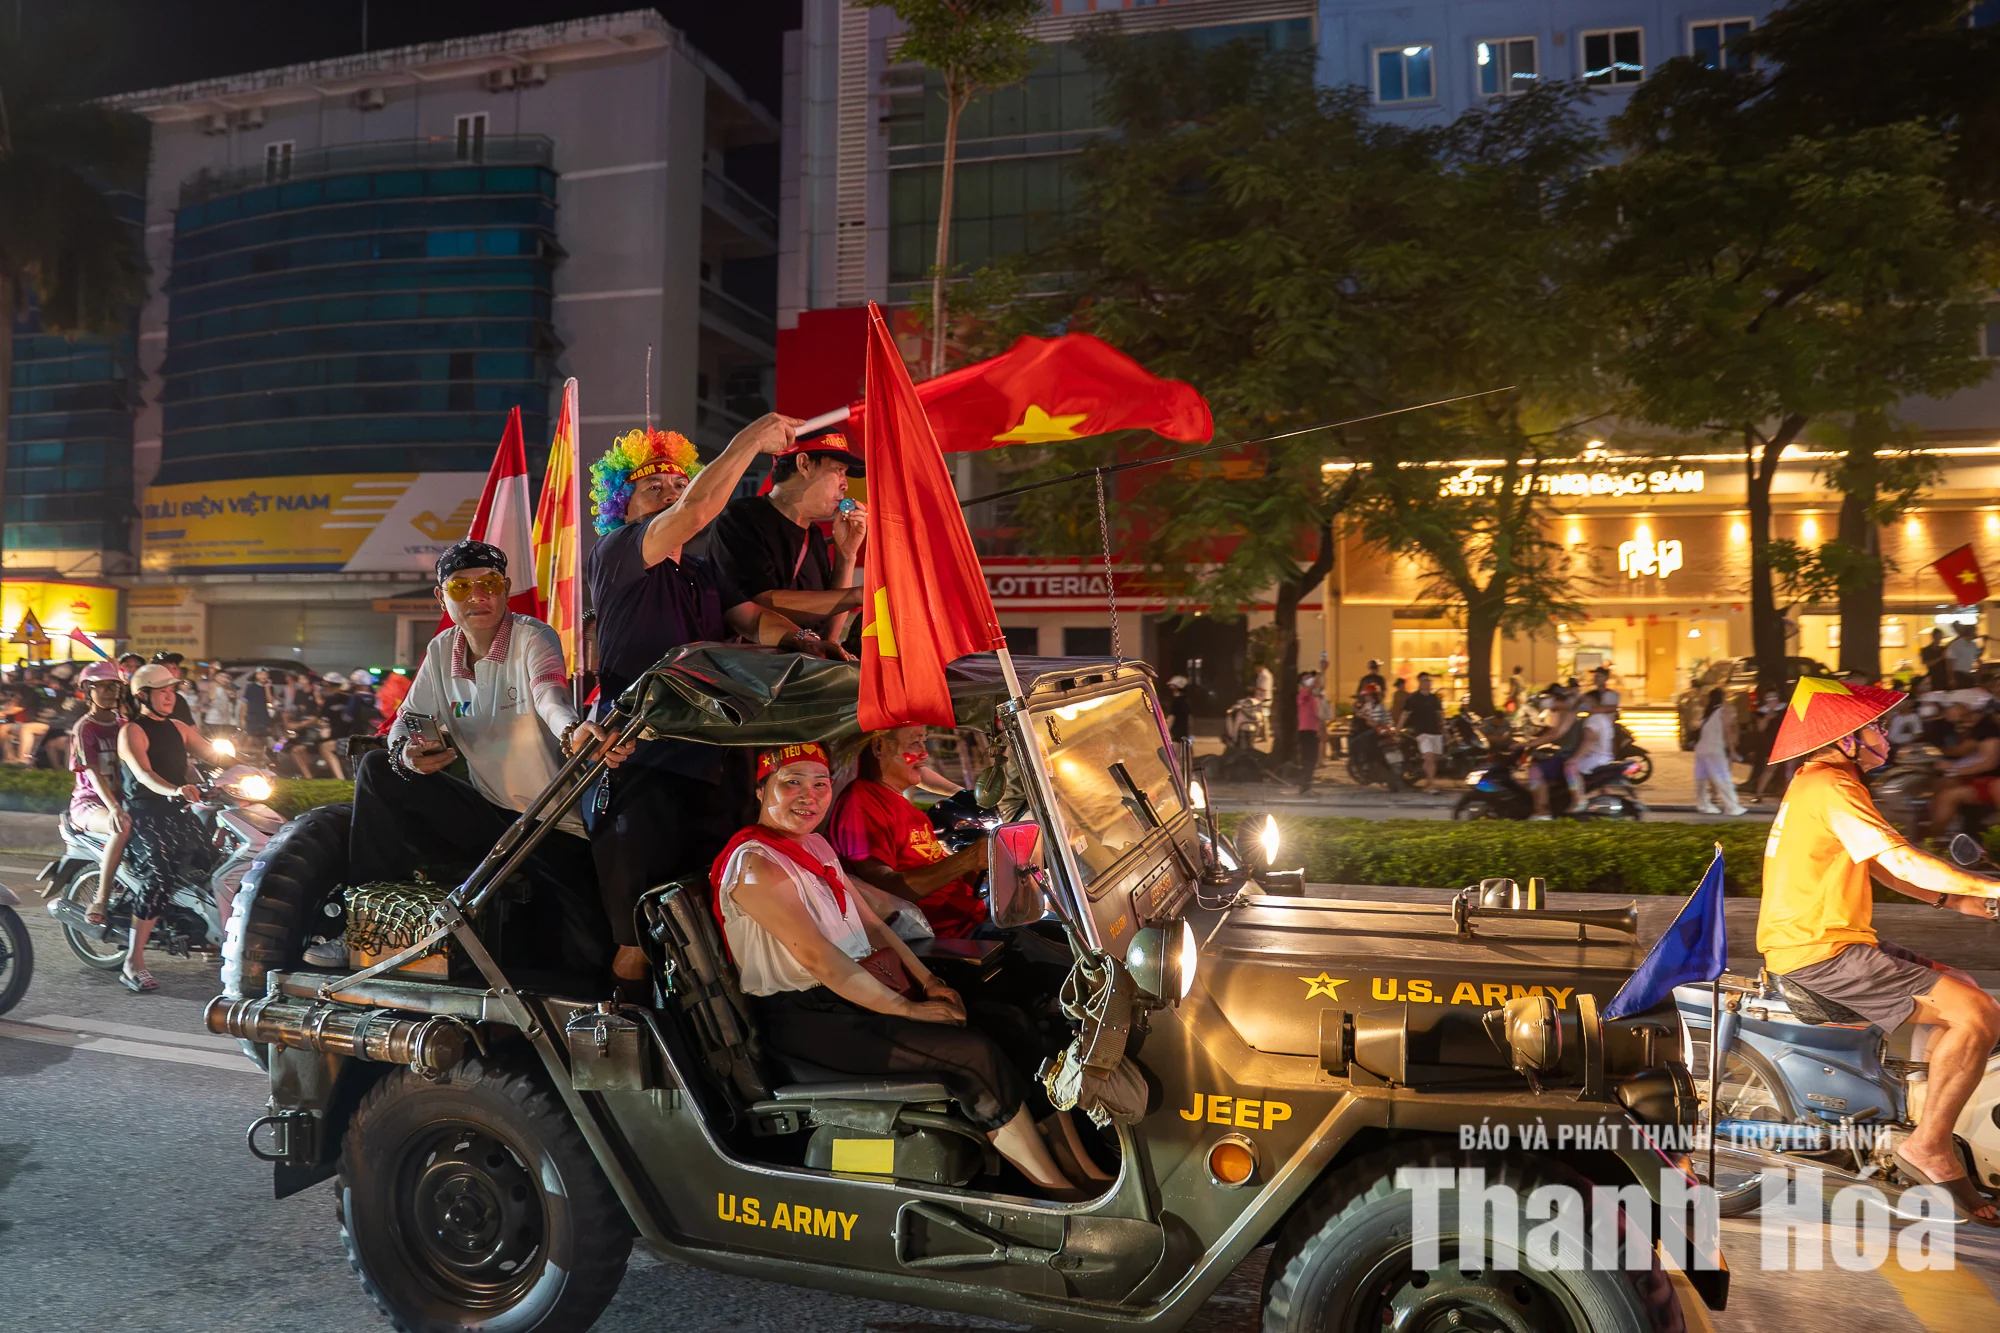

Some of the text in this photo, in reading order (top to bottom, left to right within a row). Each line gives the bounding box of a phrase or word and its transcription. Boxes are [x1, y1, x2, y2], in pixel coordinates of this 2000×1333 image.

[277, 493, 329, 511] NAM
[986, 576, 1107, 597] LOTTERIA
[1371, 978, 1575, 1010] U.S. ARMY
[1179, 1092, 1293, 1131] JEEP
[718, 1192, 859, 1241] U.S. ARMY
